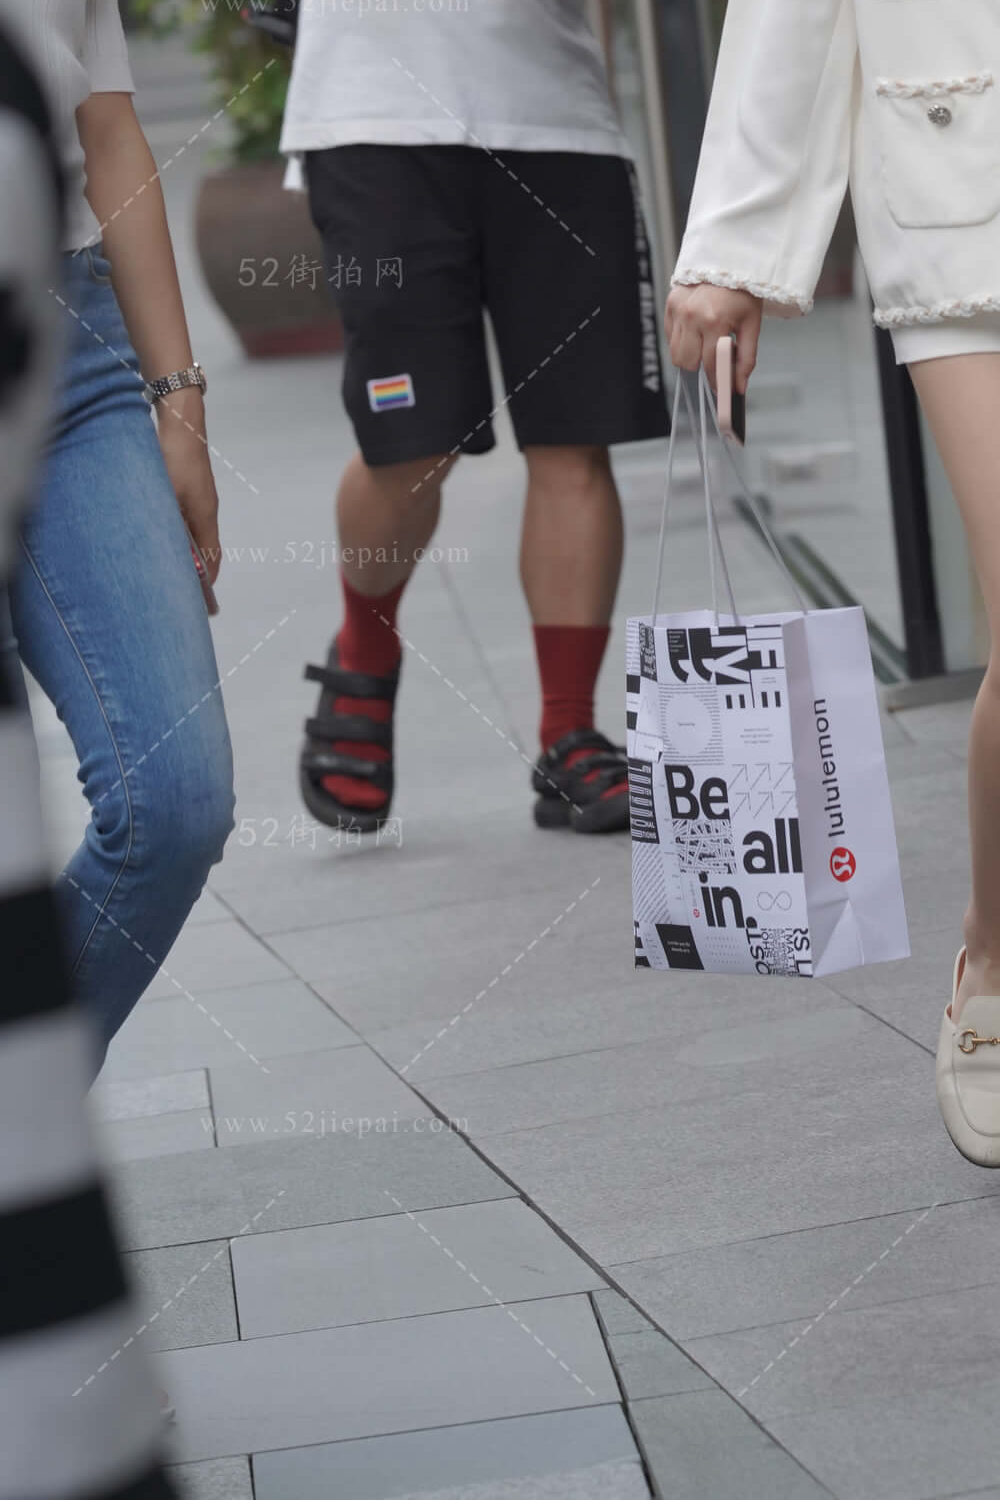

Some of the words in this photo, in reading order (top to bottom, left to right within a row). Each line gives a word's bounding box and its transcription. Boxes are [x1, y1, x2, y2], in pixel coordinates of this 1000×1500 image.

[664, 764, 731, 820] Be
[814, 699, 846, 838] lululemon
[742, 818, 803, 874] all
[698, 873, 758, 929] in.
